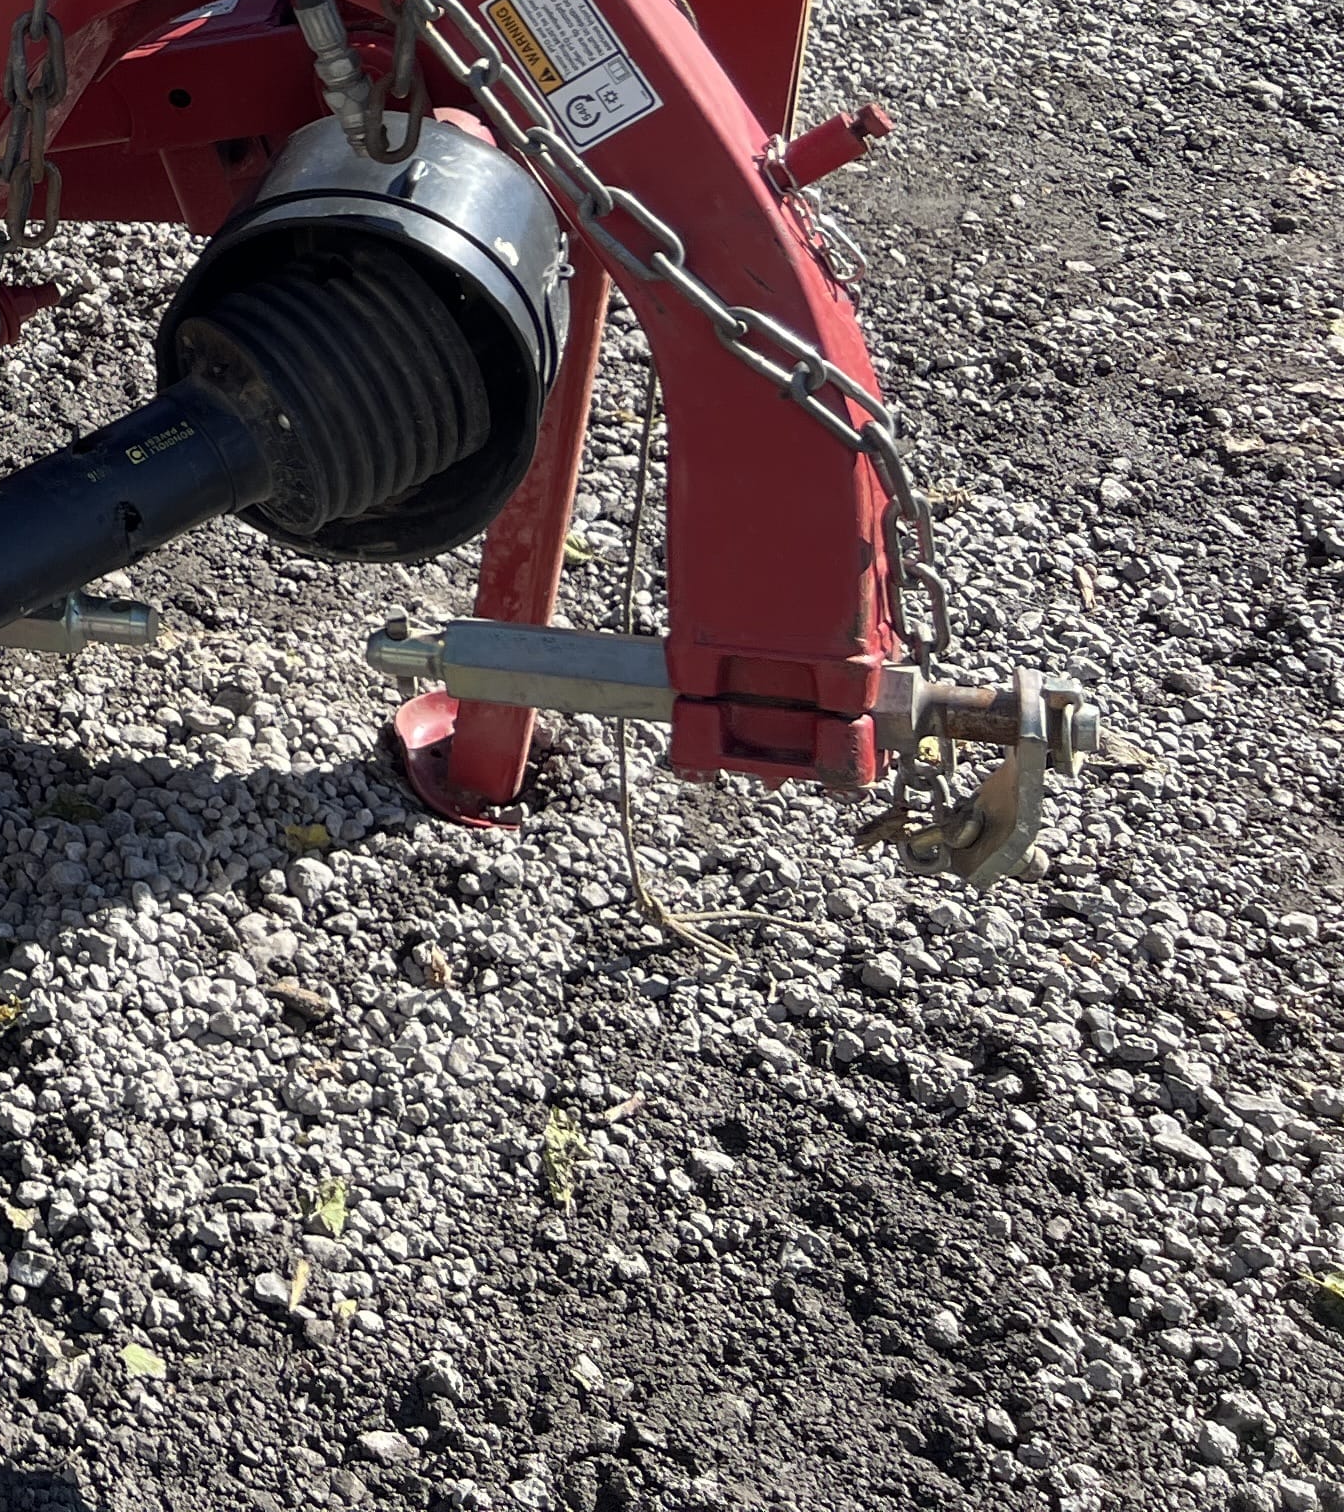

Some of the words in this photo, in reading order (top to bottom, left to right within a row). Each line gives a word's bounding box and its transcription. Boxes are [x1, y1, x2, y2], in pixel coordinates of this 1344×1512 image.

[554, 3, 575, 28] comply
[496, 6, 541, 66] WARNING
[546, 27, 560, 44] MUST
[571, 29, 579, 37] to
[544, 39, 556, 53] PTO
[563, 37, 575, 51] PTO
[576, 37, 596, 62] Failure
[574, 102, 592, 122] 540
[145, 426, 178, 447] PAVESI
